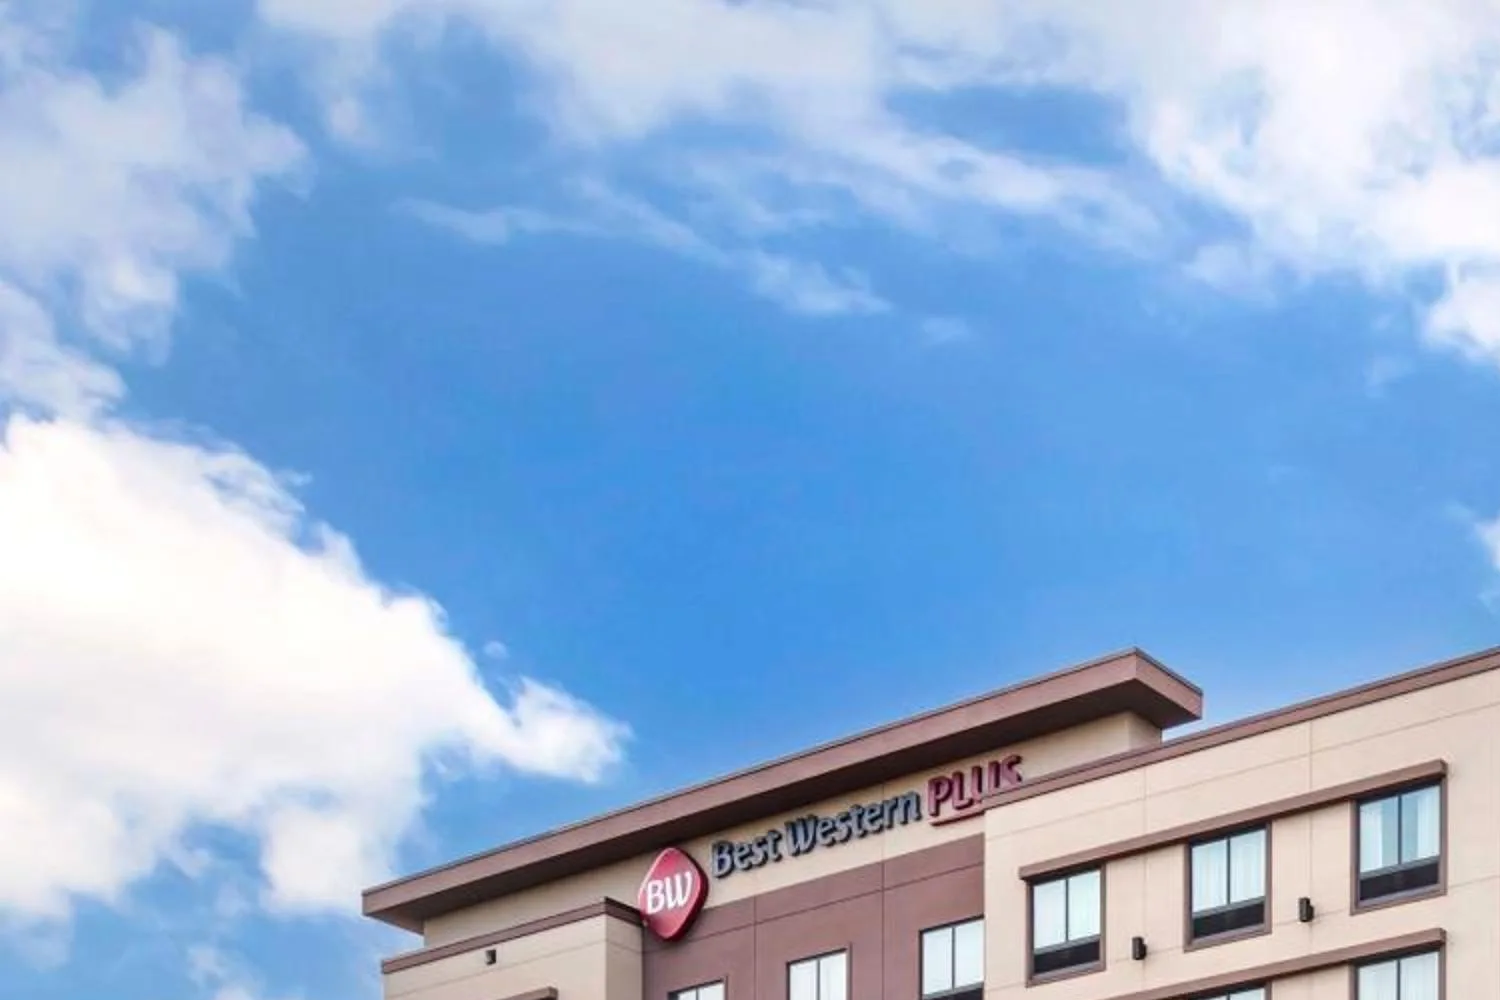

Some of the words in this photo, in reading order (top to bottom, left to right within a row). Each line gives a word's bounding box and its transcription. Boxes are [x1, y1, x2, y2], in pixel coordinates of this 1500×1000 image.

[711, 829, 783, 879] Best
[784, 791, 922, 857] Western
[646, 871, 692, 914] BW
